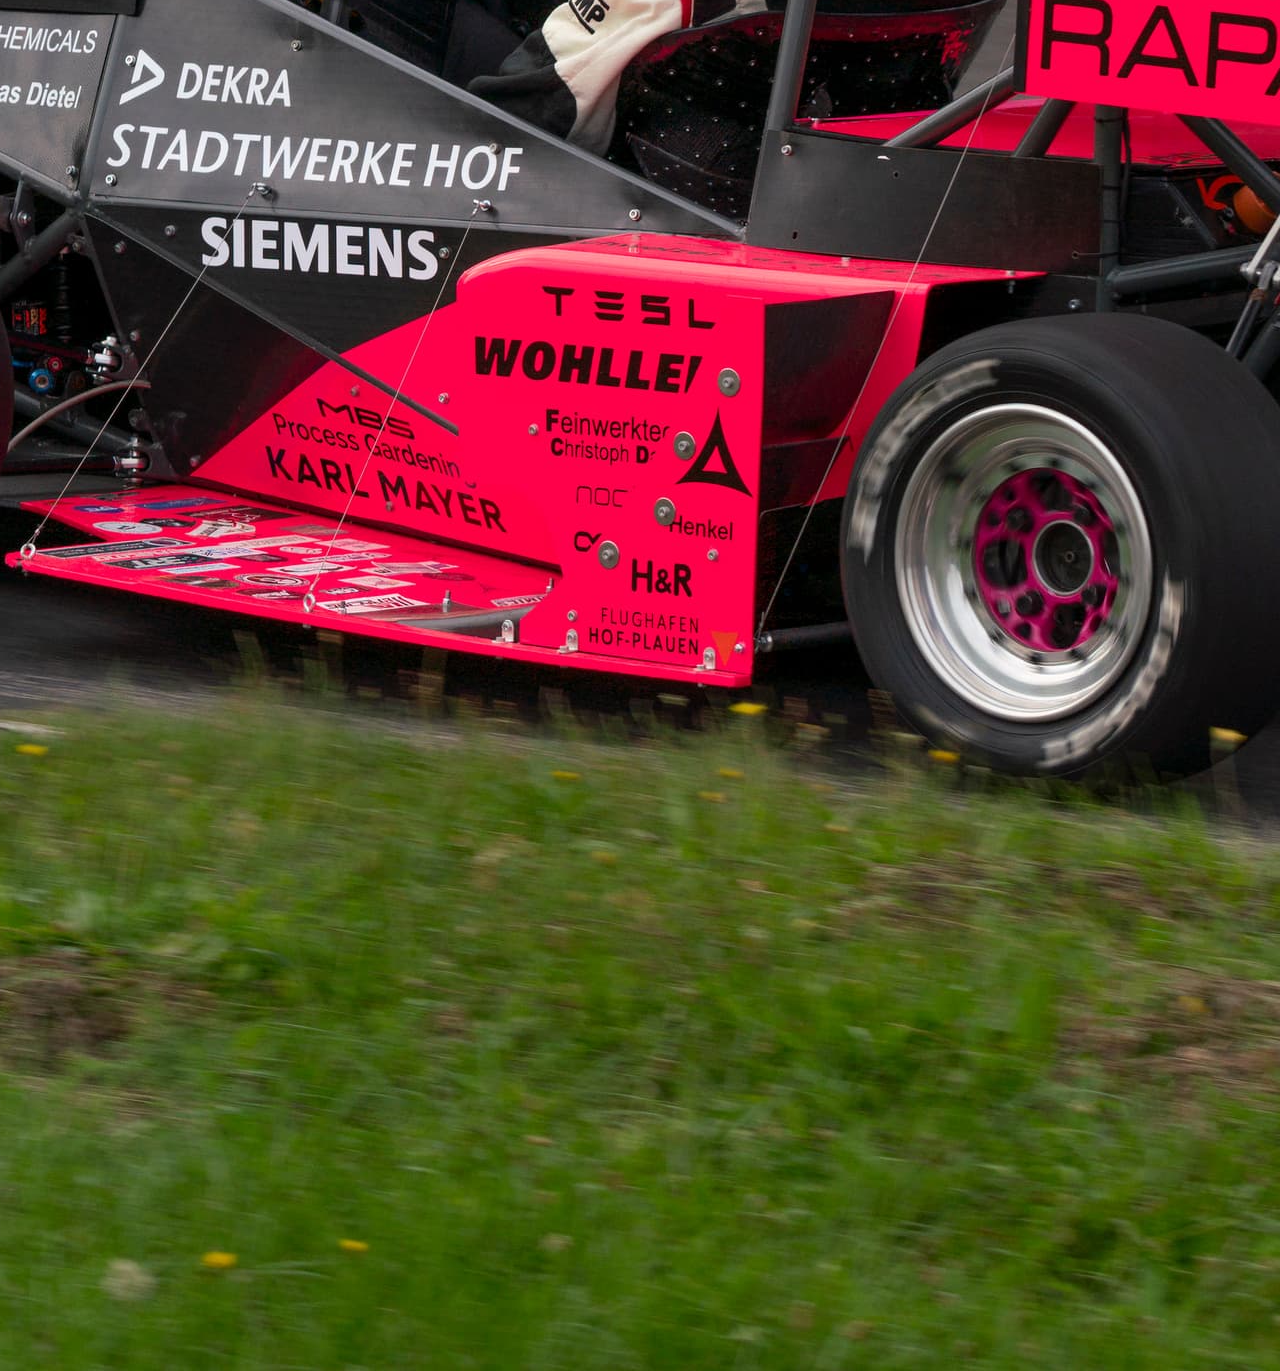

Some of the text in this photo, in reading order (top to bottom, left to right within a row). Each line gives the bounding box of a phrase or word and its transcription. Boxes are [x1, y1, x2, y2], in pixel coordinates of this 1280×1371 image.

[26, 82, 81, 108] Dietel
[177, 63, 290, 107] DEKRA
[106, 124, 522, 190] STADTWERKE HOF
[202, 217, 438, 280] SIEMENS
[273, 413, 359, 451] Process
[316, 398, 415, 440] MBS
[551, 438, 629, 466] Christoph
[266, 446, 506, 532] KARL MAYER
[670, 516, 733, 540] Henkel
[632, 559, 692, 597] H&R
[602, 608, 698, 633] FLUGHAFEN
[590, 628, 698, 655] HOF-PLAUEN
